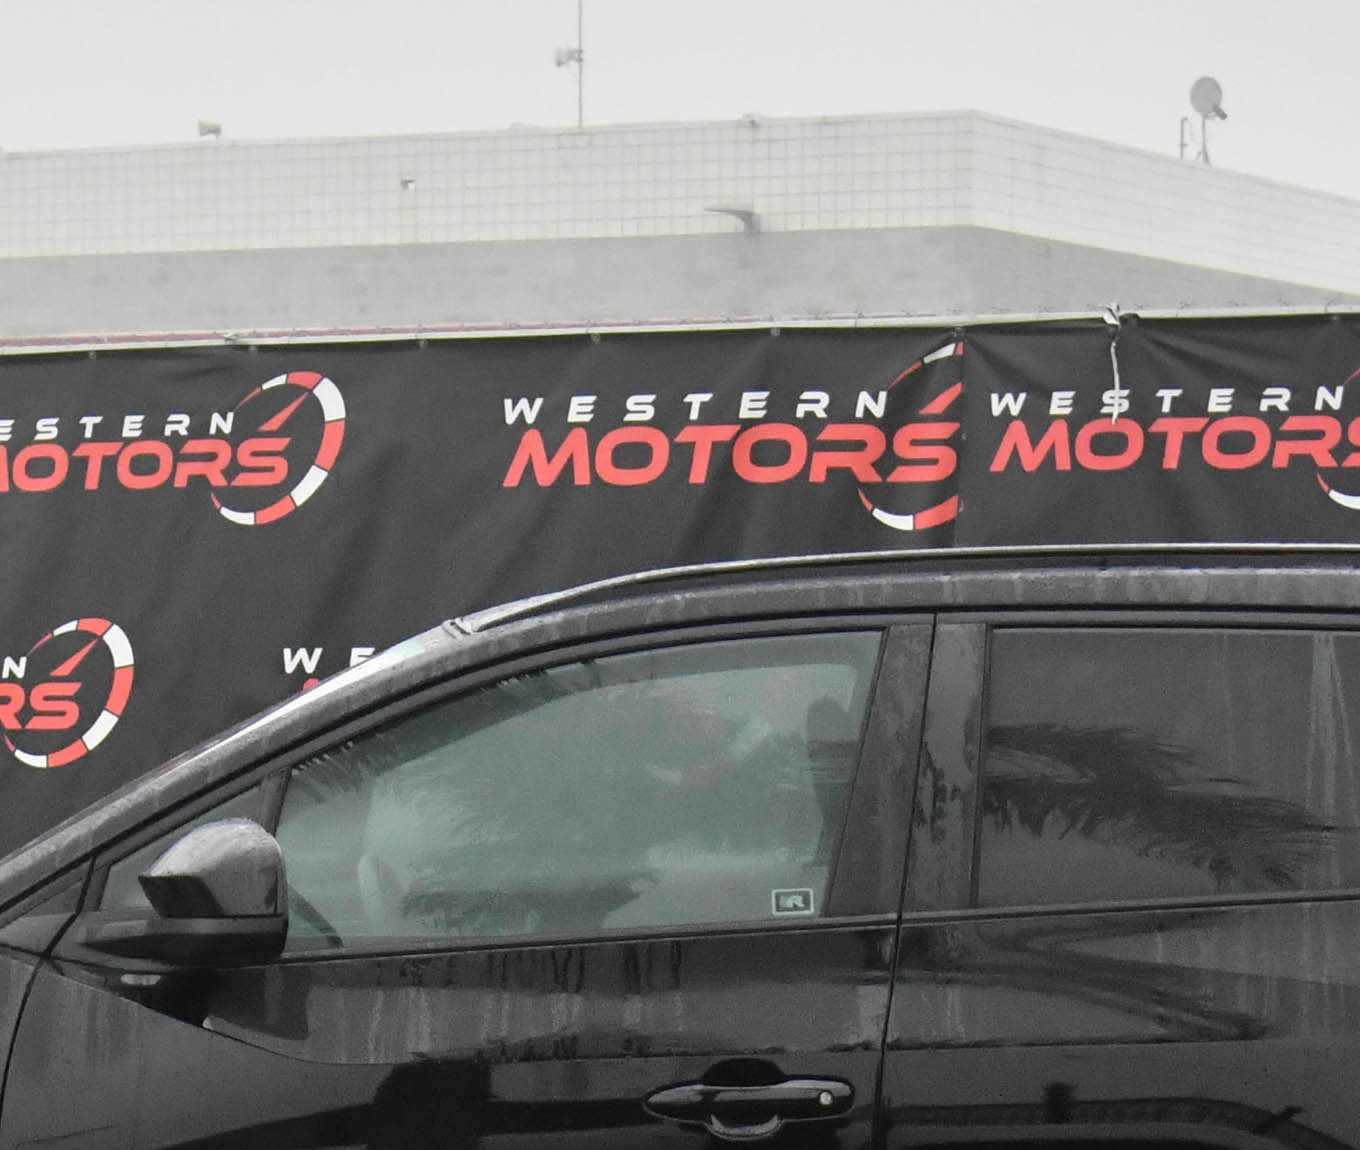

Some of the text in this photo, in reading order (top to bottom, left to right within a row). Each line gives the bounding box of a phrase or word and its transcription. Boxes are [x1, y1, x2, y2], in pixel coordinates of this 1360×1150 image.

[503, 390, 888, 425] WESTERN
[990, 383, 1344, 421] WESTERN
[503, 421, 961, 489] MOTORS
